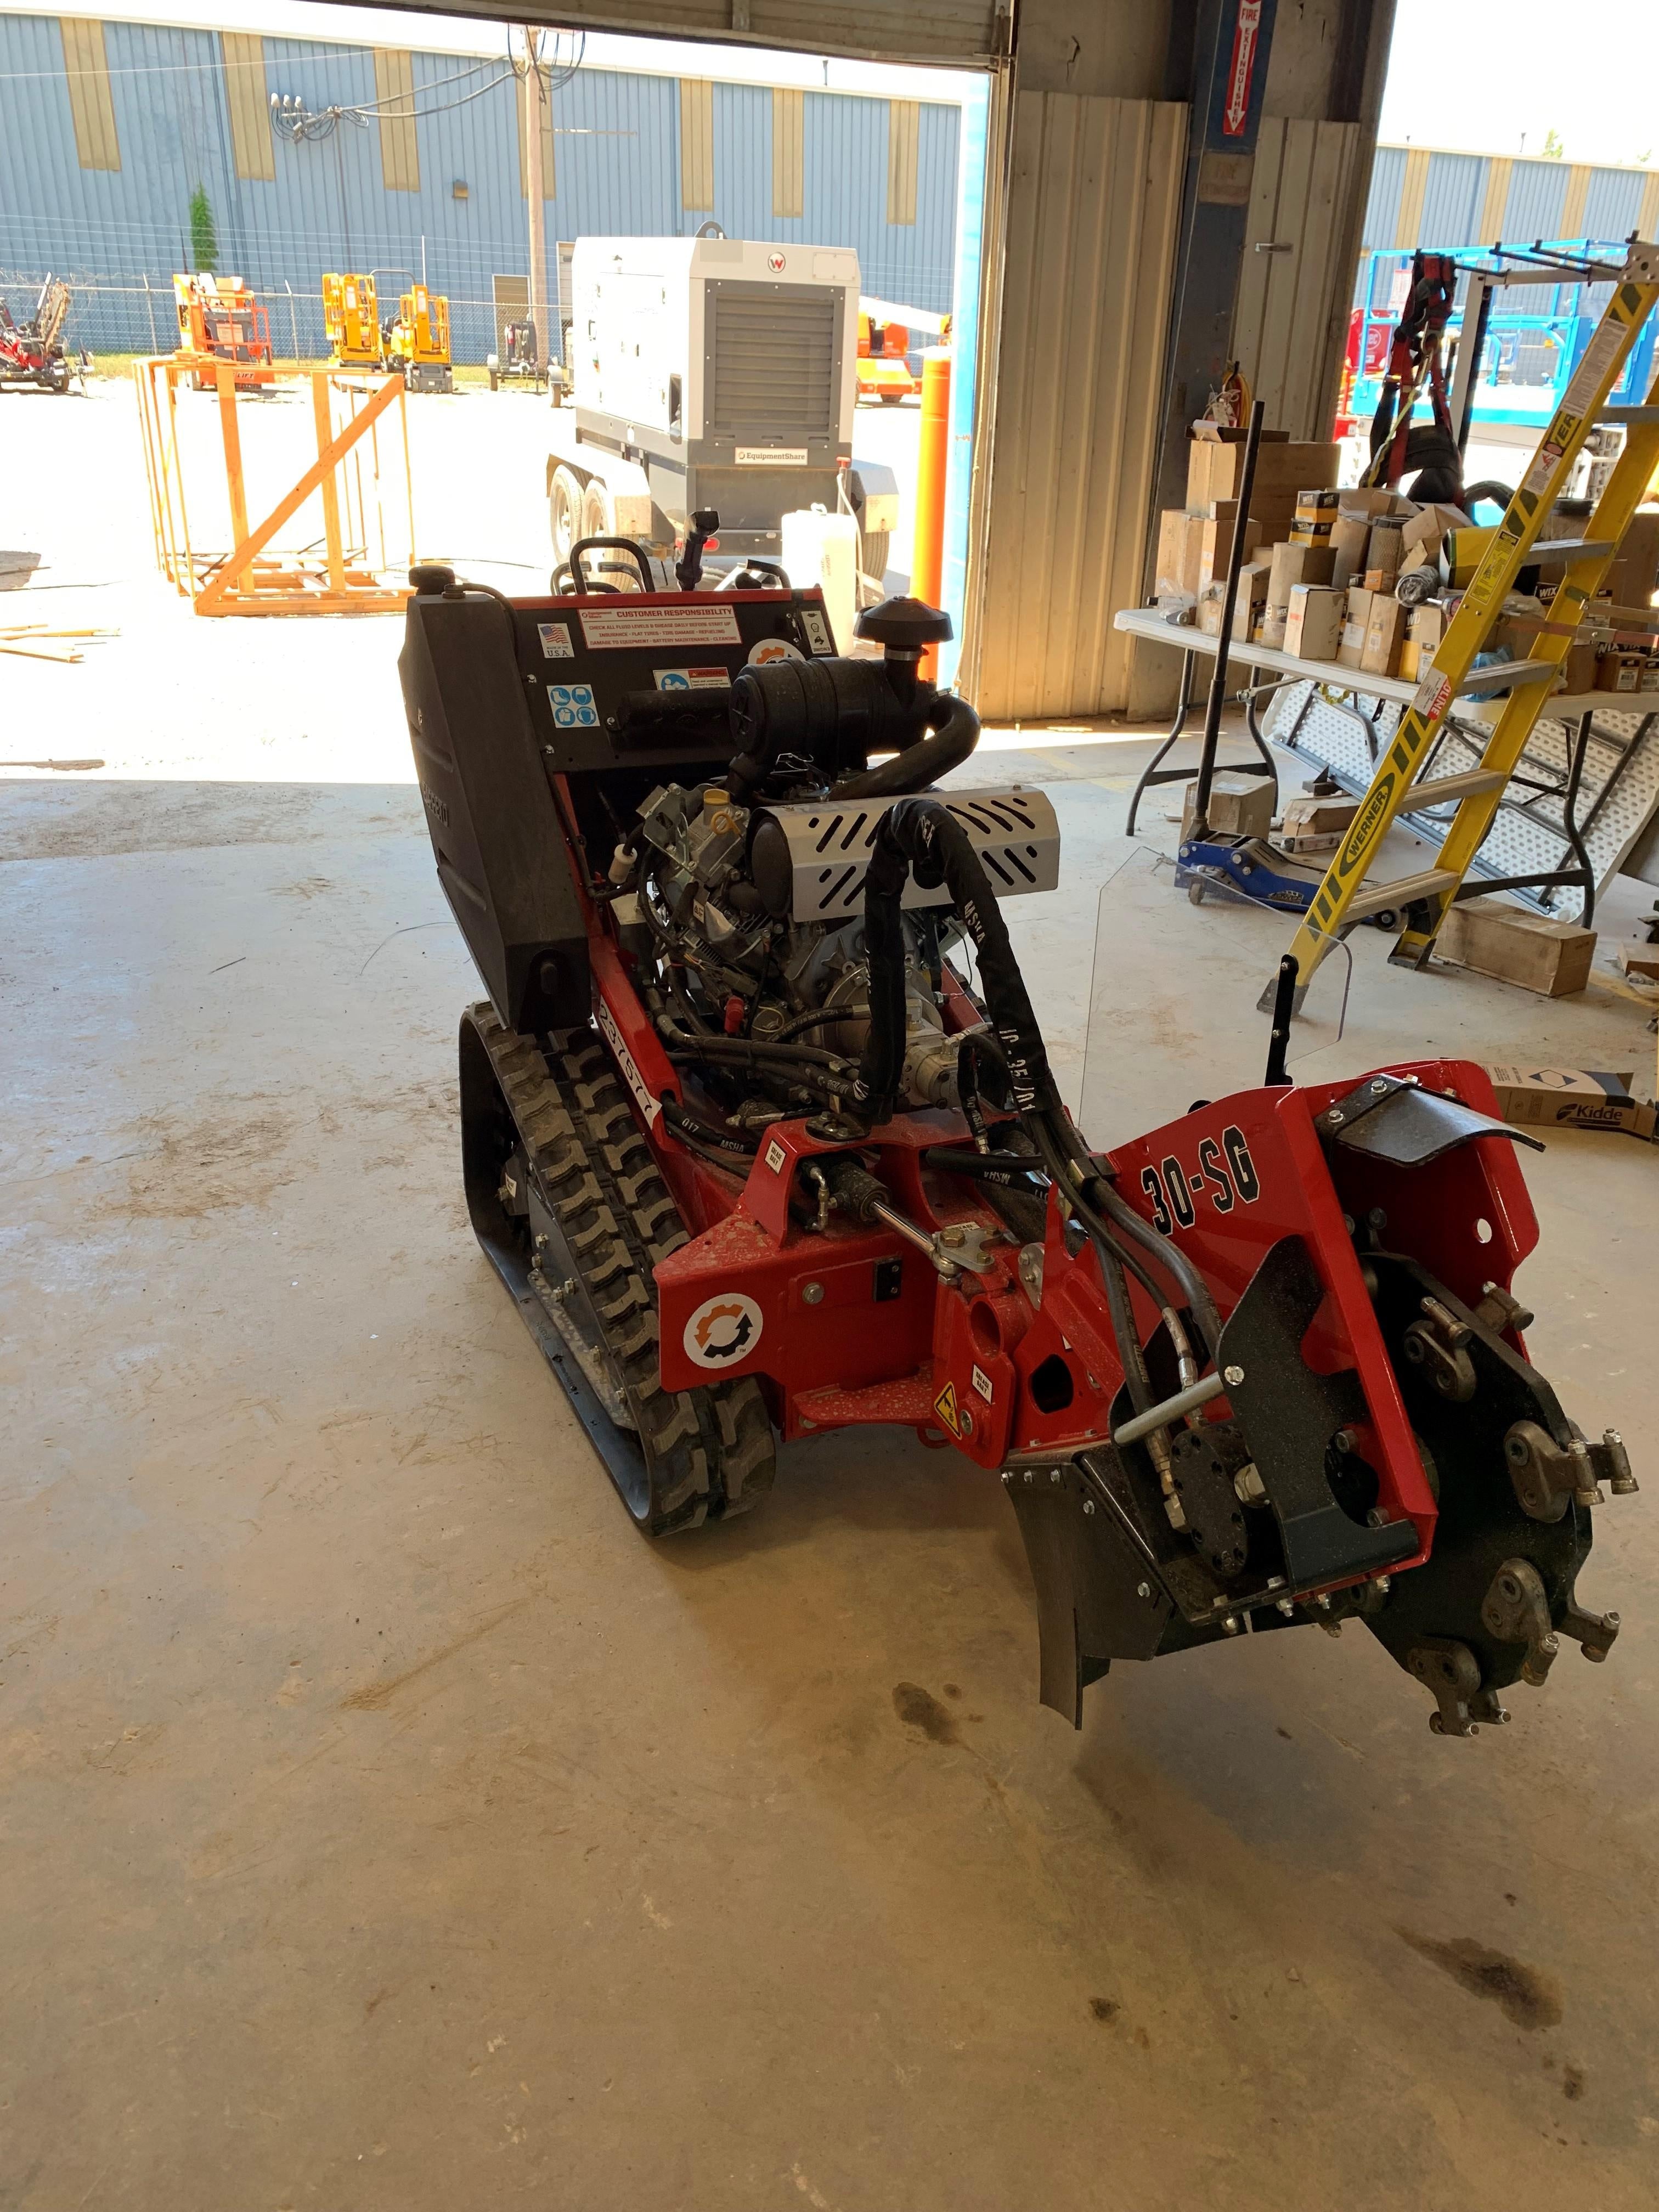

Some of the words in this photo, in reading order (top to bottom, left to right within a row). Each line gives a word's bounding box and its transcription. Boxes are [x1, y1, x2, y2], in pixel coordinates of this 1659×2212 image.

[1242, 8, 1258, 21] FIRE
[1232, 28, 1250, 123] EXTINGUISHER
[746, 452, 805, 460] EquipmentShare
[1539, 586, 1558, 598] WIX
[664, 608, 732, 617] RESPONSIBILITY
[1277, 607, 1288, 616] WIX
[601, 1004, 653, 1112] 237577
[1577, 1105, 1622, 1120] Kidde
[720, 1139, 744, 1153] MSHA
[770, 1154, 778, 1166] DAILY
[771, 1147, 782, 1161] GREASE
[1141, 1124, 1260, 1237] 30-SG
[976, 1372, 990, 1390] GREASE
[977, 1380, 987, 1394] DAILY
